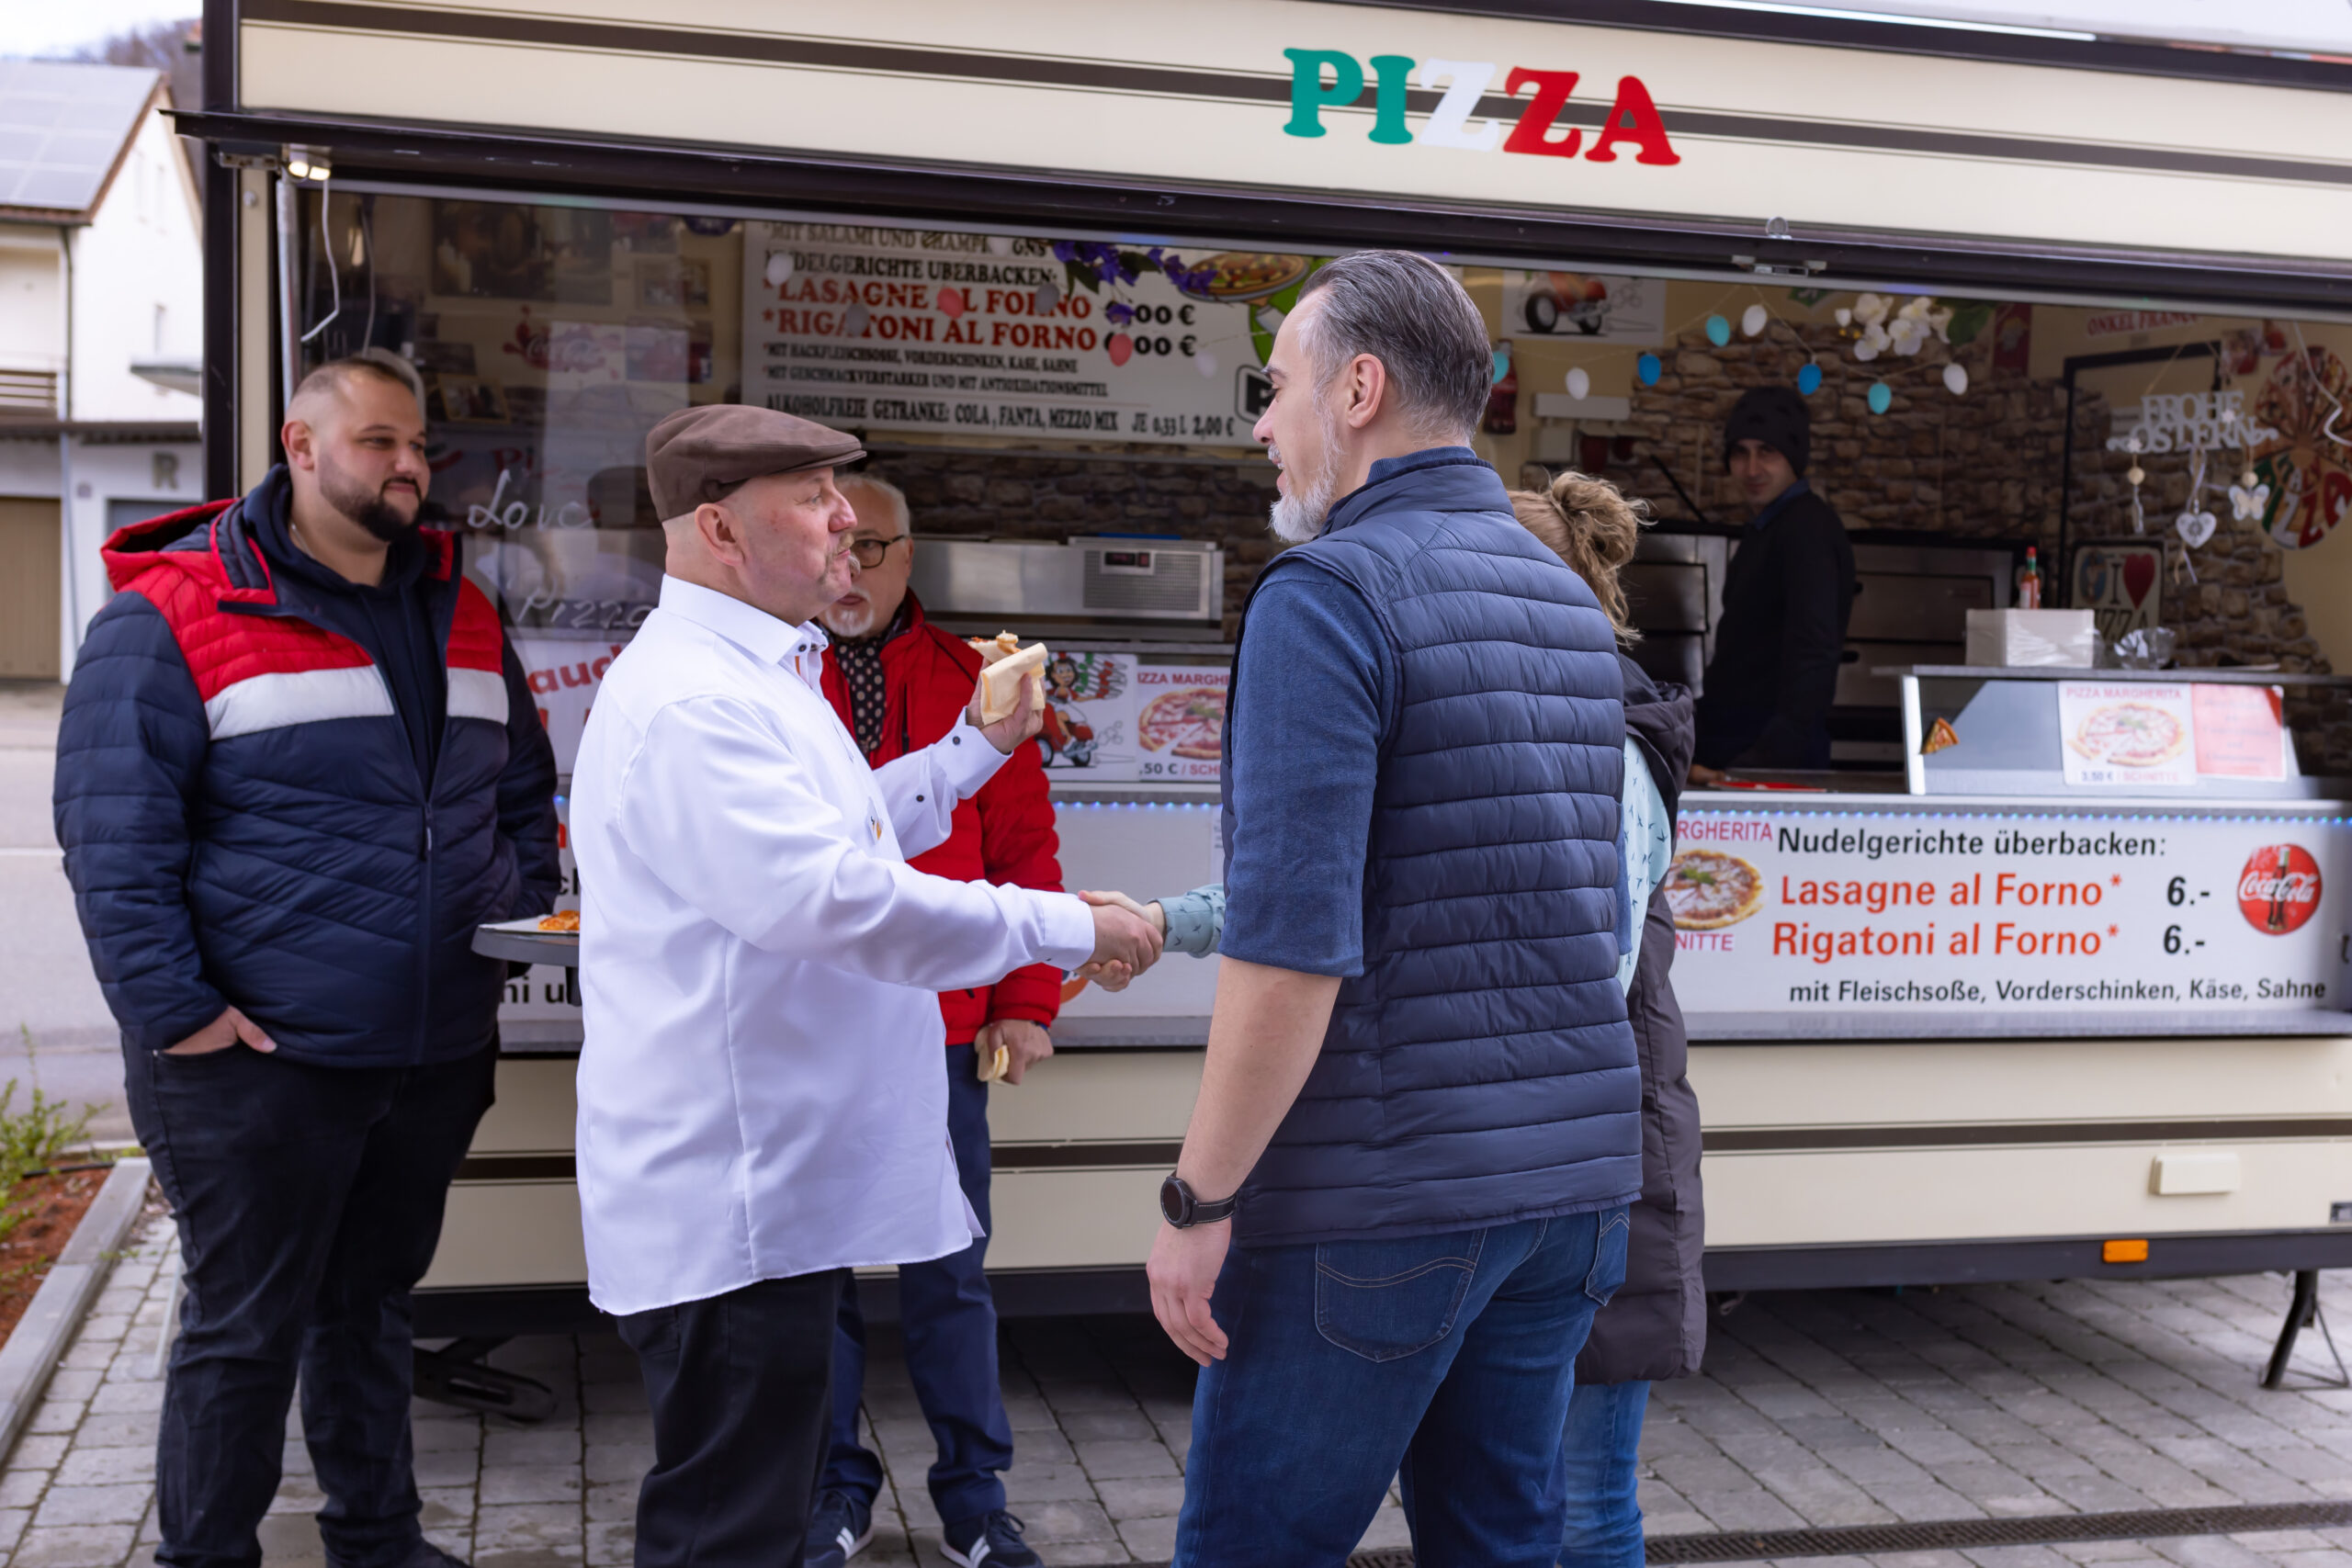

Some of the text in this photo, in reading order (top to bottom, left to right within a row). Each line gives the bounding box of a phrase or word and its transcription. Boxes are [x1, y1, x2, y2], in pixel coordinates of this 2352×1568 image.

[1283, 47, 1680, 165] PIZZA
[1179, 304, 1195, 325] €
[943, 320, 984, 344] AL
[991, 321, 1097, 351] FORNO
[1180, 334, 1196, 357] €
[1049, 408, 1091, 430] MEZZO
[1094, 411, 1118, 432] MIX
[2142, 391, 2245, 428] FROHE
[468, 468, 593, 533] Love
[2067, 687, 2181, 700] PIZZA MARGHERITA
[1779, 827, 2165, 860] Nudelgerichte überbacken:
[1781, 874, 1935, 914] Lasagne
[1950, 873, 1981, 906] al
[1773, 921, 1935, 964] Rigatoni
[1949, 922, 1980, 955] al
[1790, 978, 2326, 1004] mit Fleischsoße, Vorderschinken, Käse, Sahne
